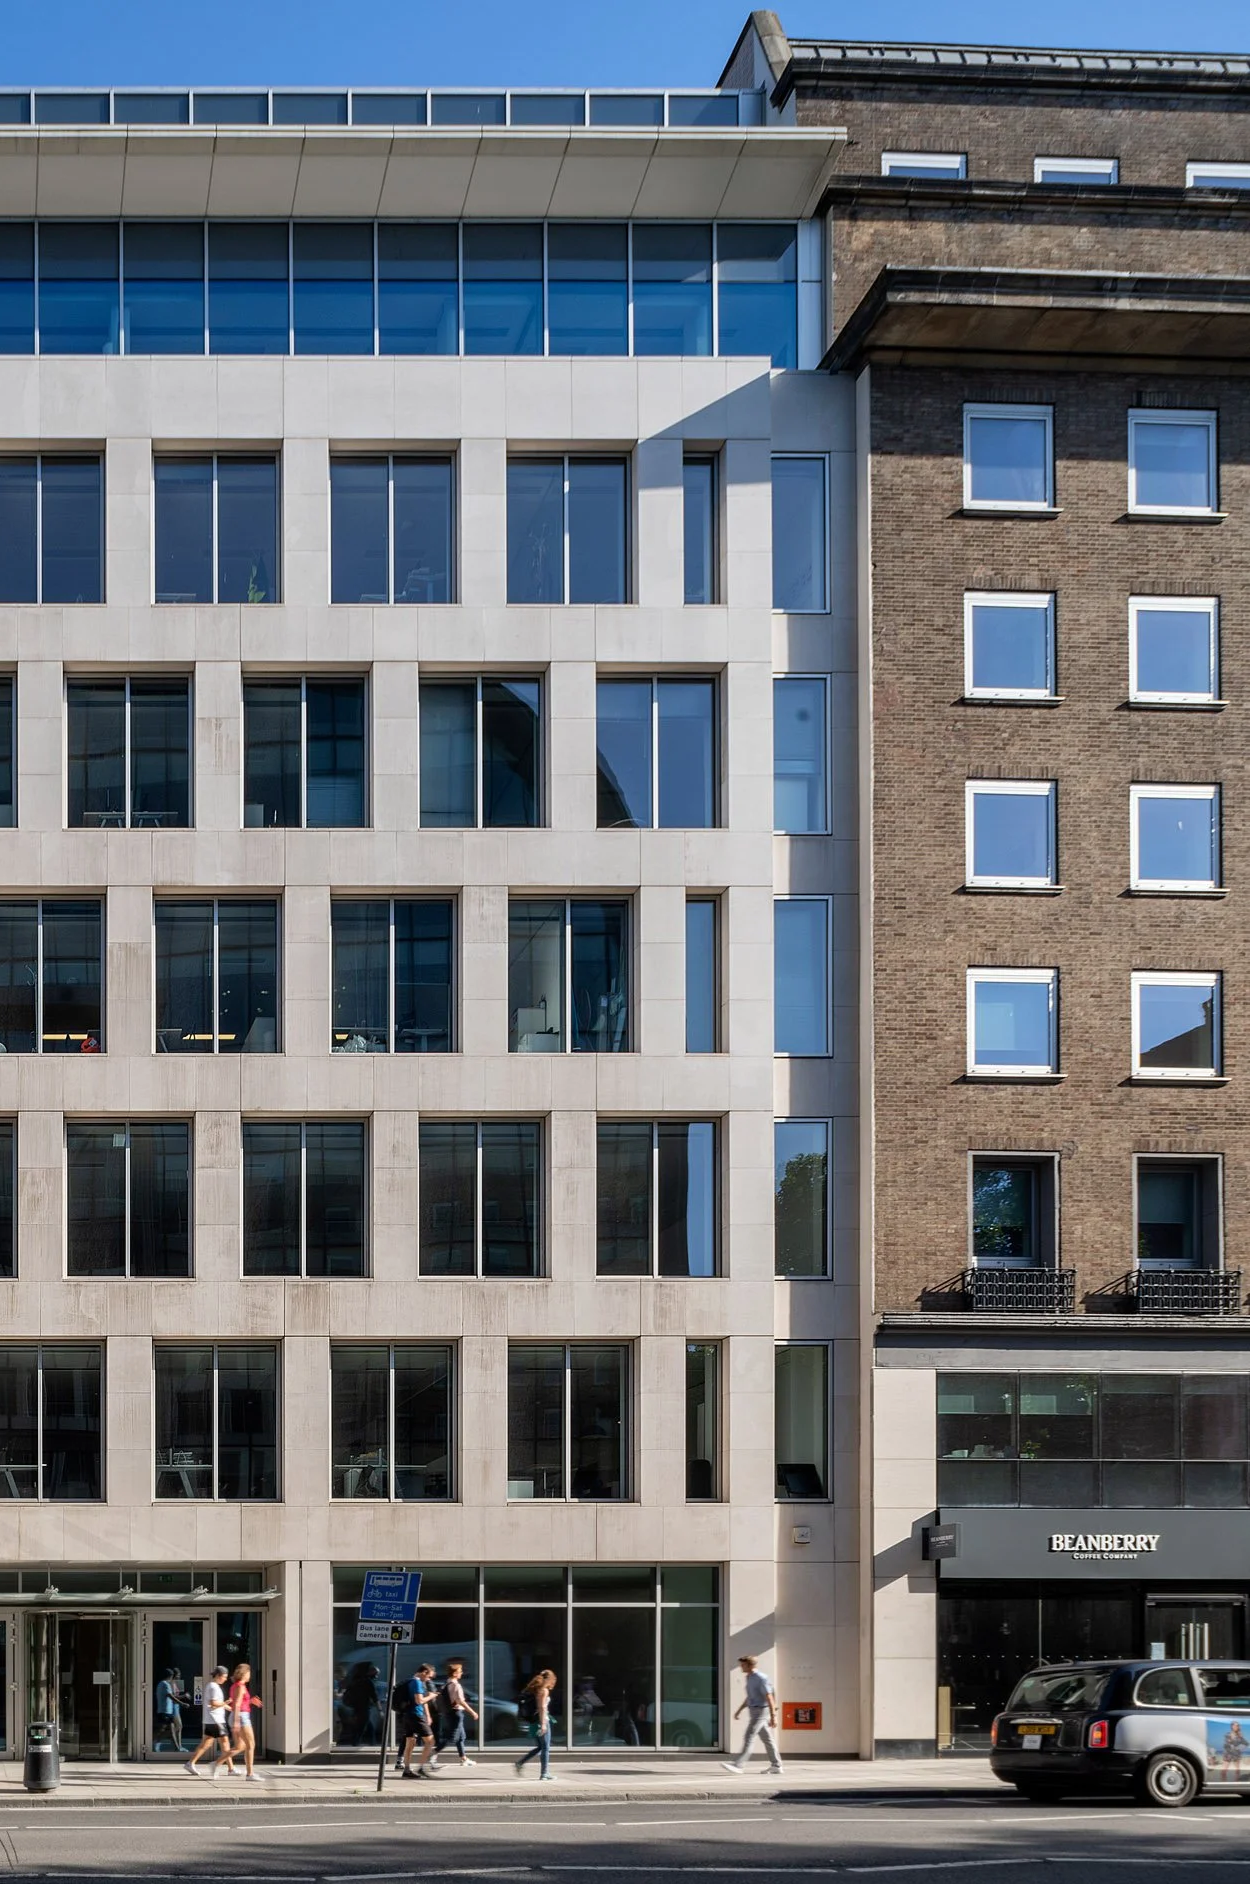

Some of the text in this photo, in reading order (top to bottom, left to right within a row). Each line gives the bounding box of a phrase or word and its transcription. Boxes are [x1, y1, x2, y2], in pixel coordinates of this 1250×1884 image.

[1051, 1534, 1160, 1551] BEANBERRY
[373, 1603, 403, 1611] Mon-Sat
[372, 1610, 404, 1619] 7am-7pm
